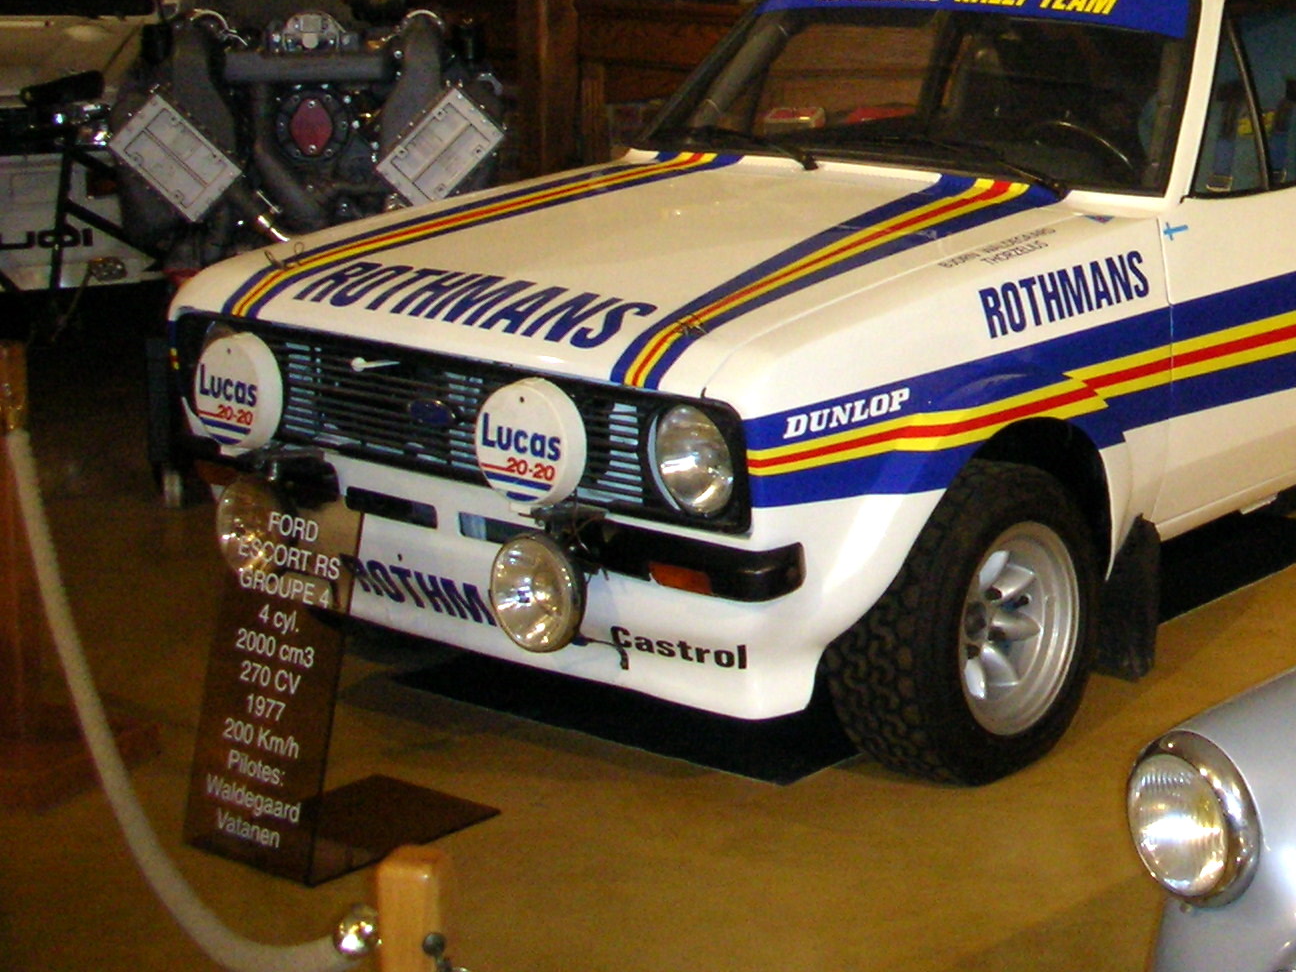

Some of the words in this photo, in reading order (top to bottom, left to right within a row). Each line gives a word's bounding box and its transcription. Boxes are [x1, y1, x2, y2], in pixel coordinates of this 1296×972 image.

[294, 261, 658, 350] ROTHMANS
[978, 250, 1150, 339] ROTHMANS
[199, 364, 258, 407] Lucas
[218, 404, 253, 426] 20-20
[783, 387, 910, 439] DUNLOP
[482, 412, 561, 462] Lucas
[506, 457, 555, 481] 20-20
[268, 511, 319, 543] FORD
[238, 536, 312, 572] ESCORT
[314, 553, 342, 580] RS
[239, 568, 316, 606] GROUPE
[318, 587, 331, 609] 4
[339, 553, 498, 628] ROTHM
[258, 604, 270, 623] 4
[273, 610, 300, 636] cyl.
[235, 627, 277, 658] 2000
[279, 643, 316, 669] cm3
[610, 625, 748, 670] Castrol
[240, 660, 272, 687] 270
[274, 669, 302, 695] CV
[247, 693, 287, 722] 1977
[222, 717, 254, 746] 200
[257, 726, 300, 759] Km/h
[227, 749, 286, 787] Pilotes:
[205, 773, 302, 824] Waldegaard
[216, 807, 281, 849] Vatanen
